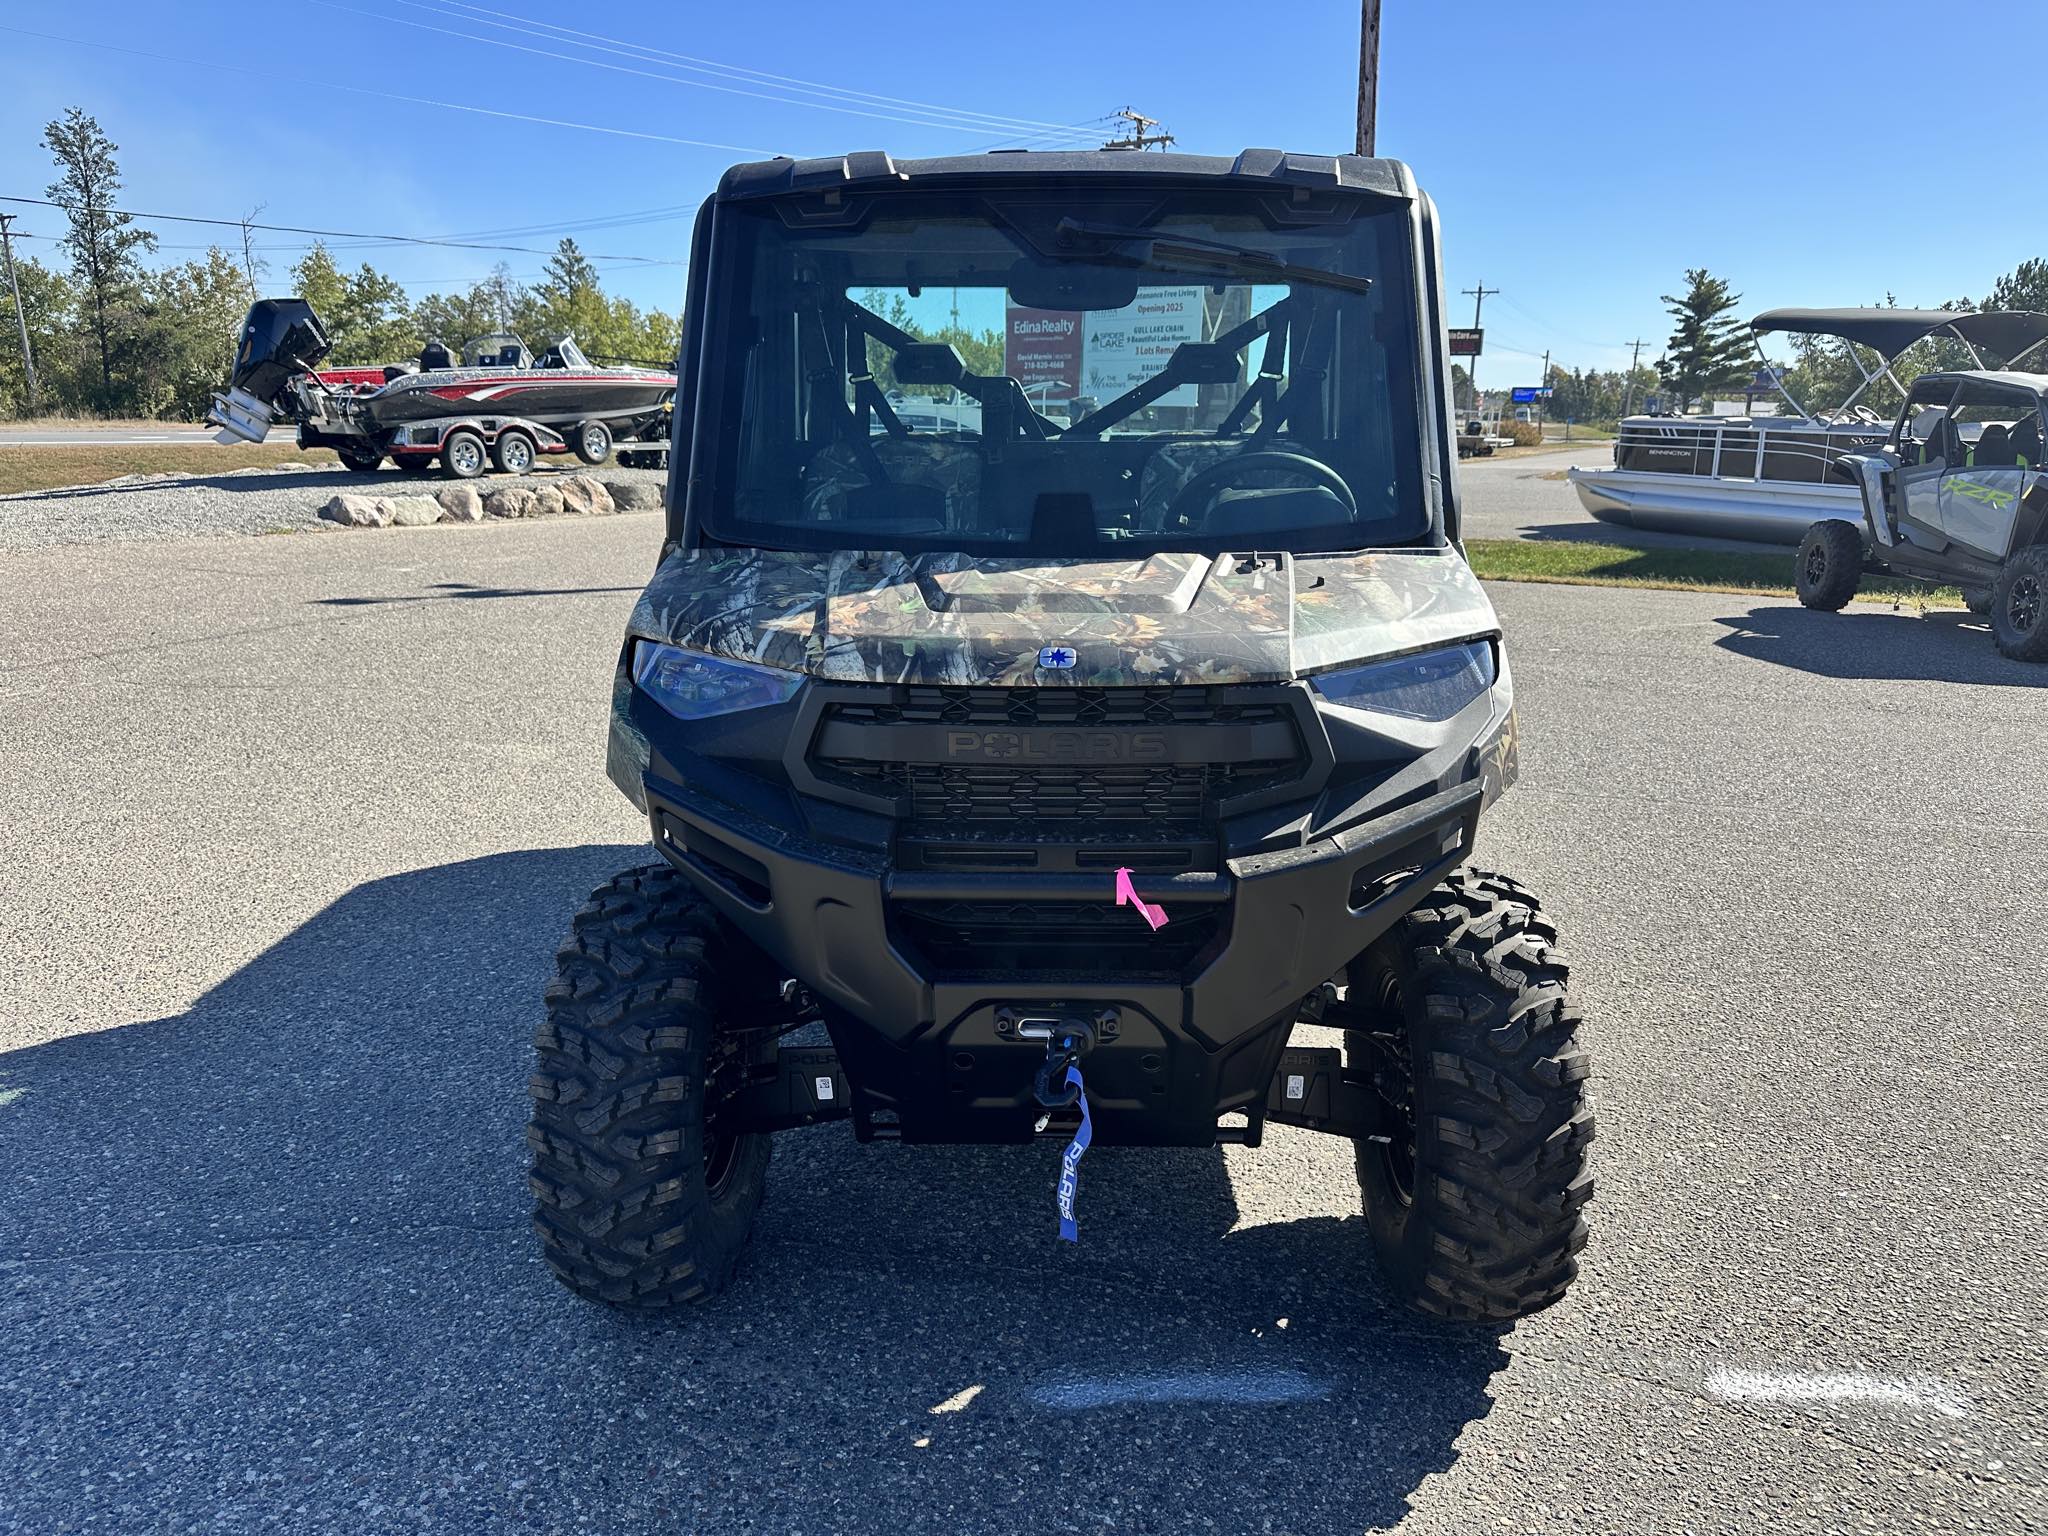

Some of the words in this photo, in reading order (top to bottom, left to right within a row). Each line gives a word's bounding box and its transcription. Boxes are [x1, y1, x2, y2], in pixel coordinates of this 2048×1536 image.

[1164, 290, 1177, 298] Free
[1178, 289, 1197, 298] Living
[1138, 303, 1165, 314] Opening
[1166, 302, 1184, 312] 2025
[1014, 320, 1041, 334] Edina
[1042, 319, 1074, 335] Realty
[1133, 326, 1148, 335] GULL
[1149, 326, 1164, 334] LAKE
[1165, 325, 1184, 333] CHAIN
[1100, 338, 1125, 348] LAKE
[1131, 335, 1156, 343] Beautiful
[1141, 346, 1154, 355] Lots
[1942, 476, 2014, 508] RZR
[948, 732, 1167, 758] POLARIS
[1060, 1141, 1084, 1222] POLARIS
